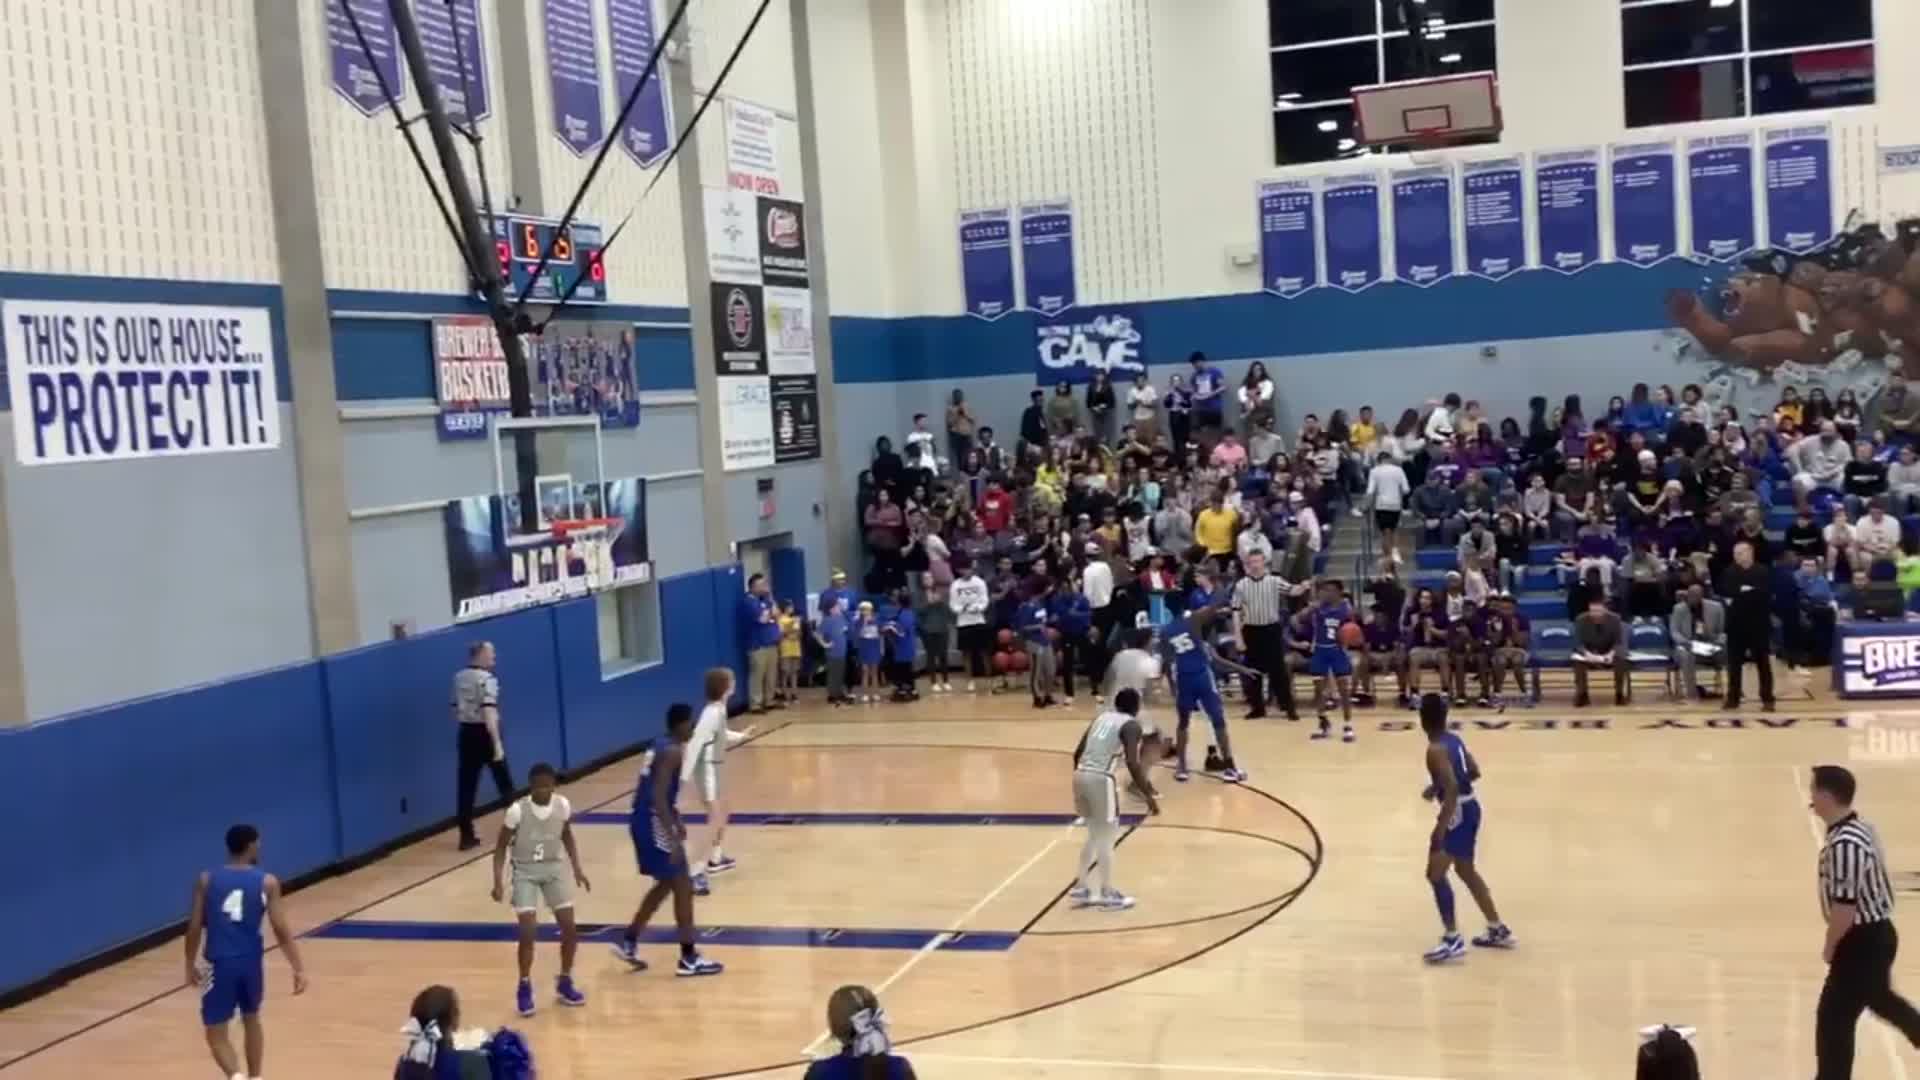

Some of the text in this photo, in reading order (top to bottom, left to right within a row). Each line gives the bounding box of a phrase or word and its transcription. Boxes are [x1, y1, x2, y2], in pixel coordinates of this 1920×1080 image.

[19, 314, 263, 365] THIS IS OUR HOUSE...
[1037, 332, 1145, 373] CAVE
[440, 360, 533, 402] BASKETB
[28, 370, 267, 457] PROTECT IT!
[221, 888, 244, 922] 4
